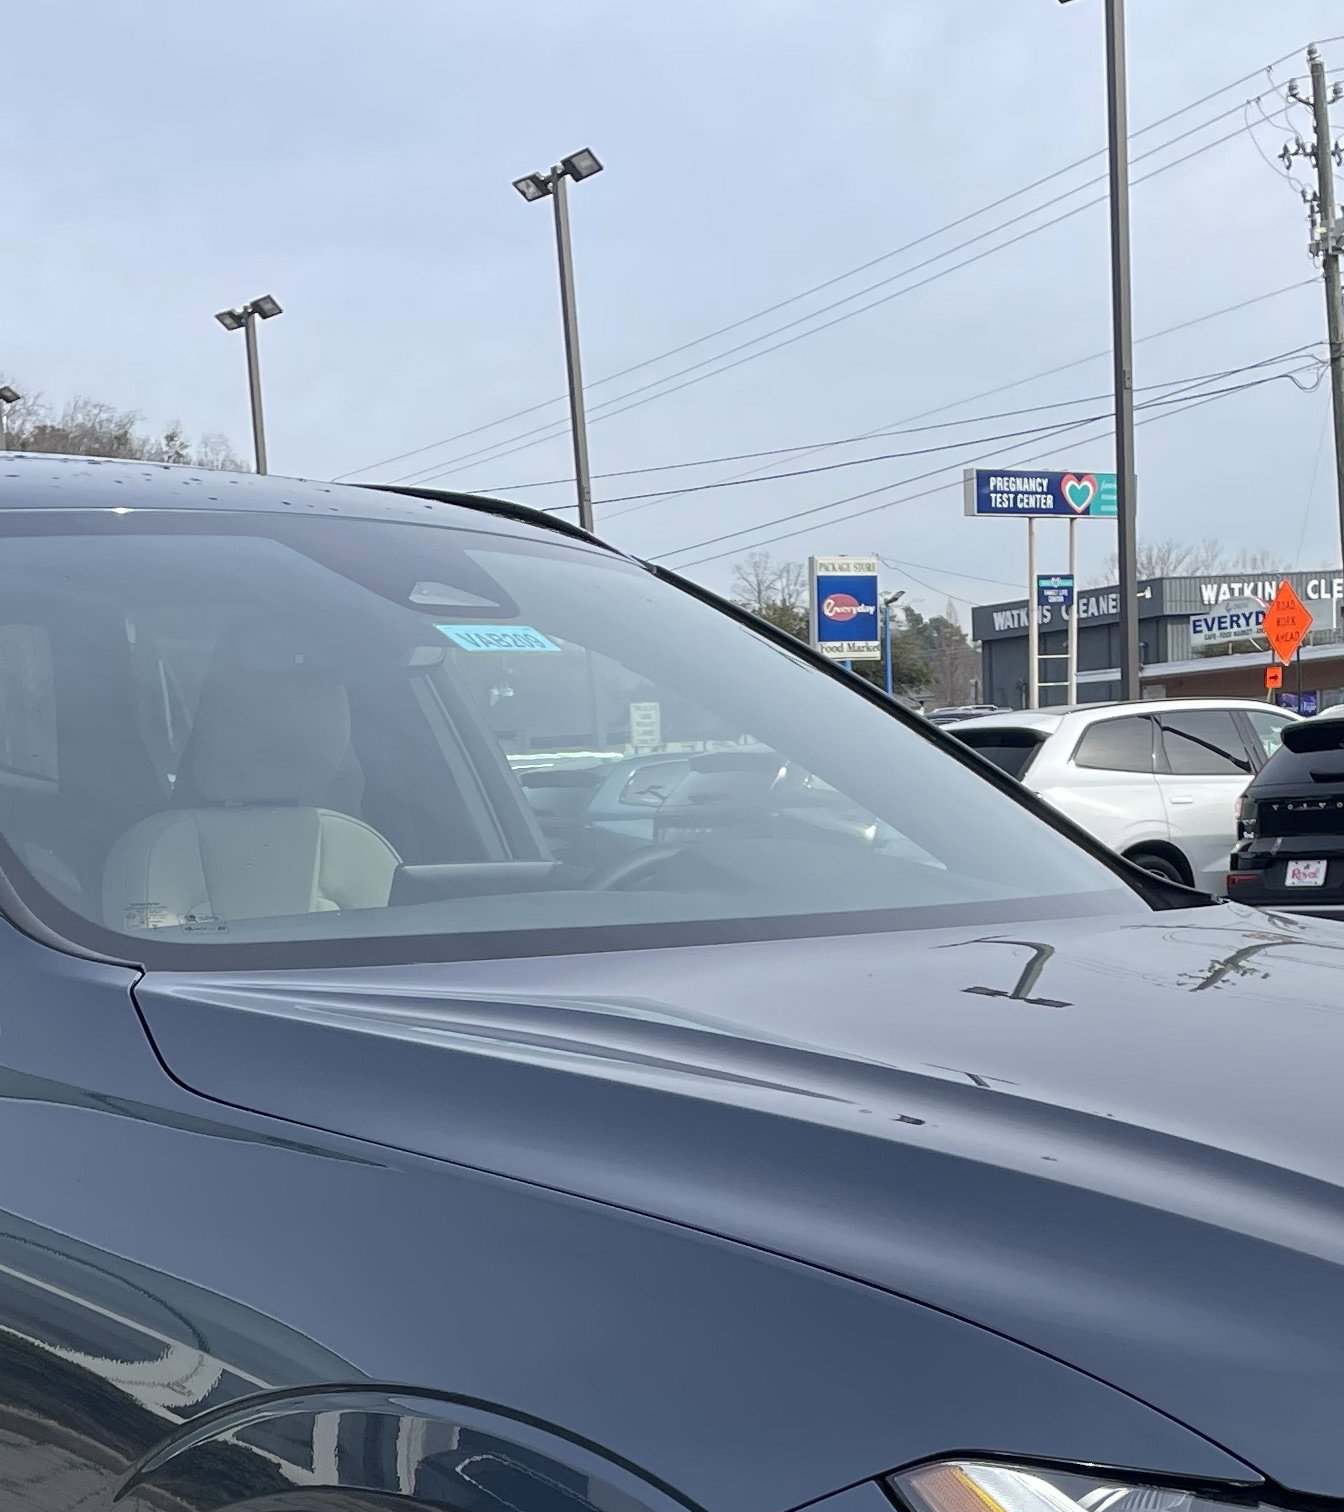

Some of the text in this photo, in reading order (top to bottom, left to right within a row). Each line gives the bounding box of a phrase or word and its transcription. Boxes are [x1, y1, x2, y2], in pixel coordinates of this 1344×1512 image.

[989, 476, 1049, 493] PREGNANCY
[990, 493, 1054, 509] TEST CENTER
[1200, 580, 1284, 605] WATKIN
[1276, 601, 1296, 610] ROAD
[1192, 610, 1265, 634] EVERYD
[1276, 616, 1297, 626] WORK
[1275, 631, 1300, 642] AHEAD
[1272, 802, 1344, 811] VOLVO
